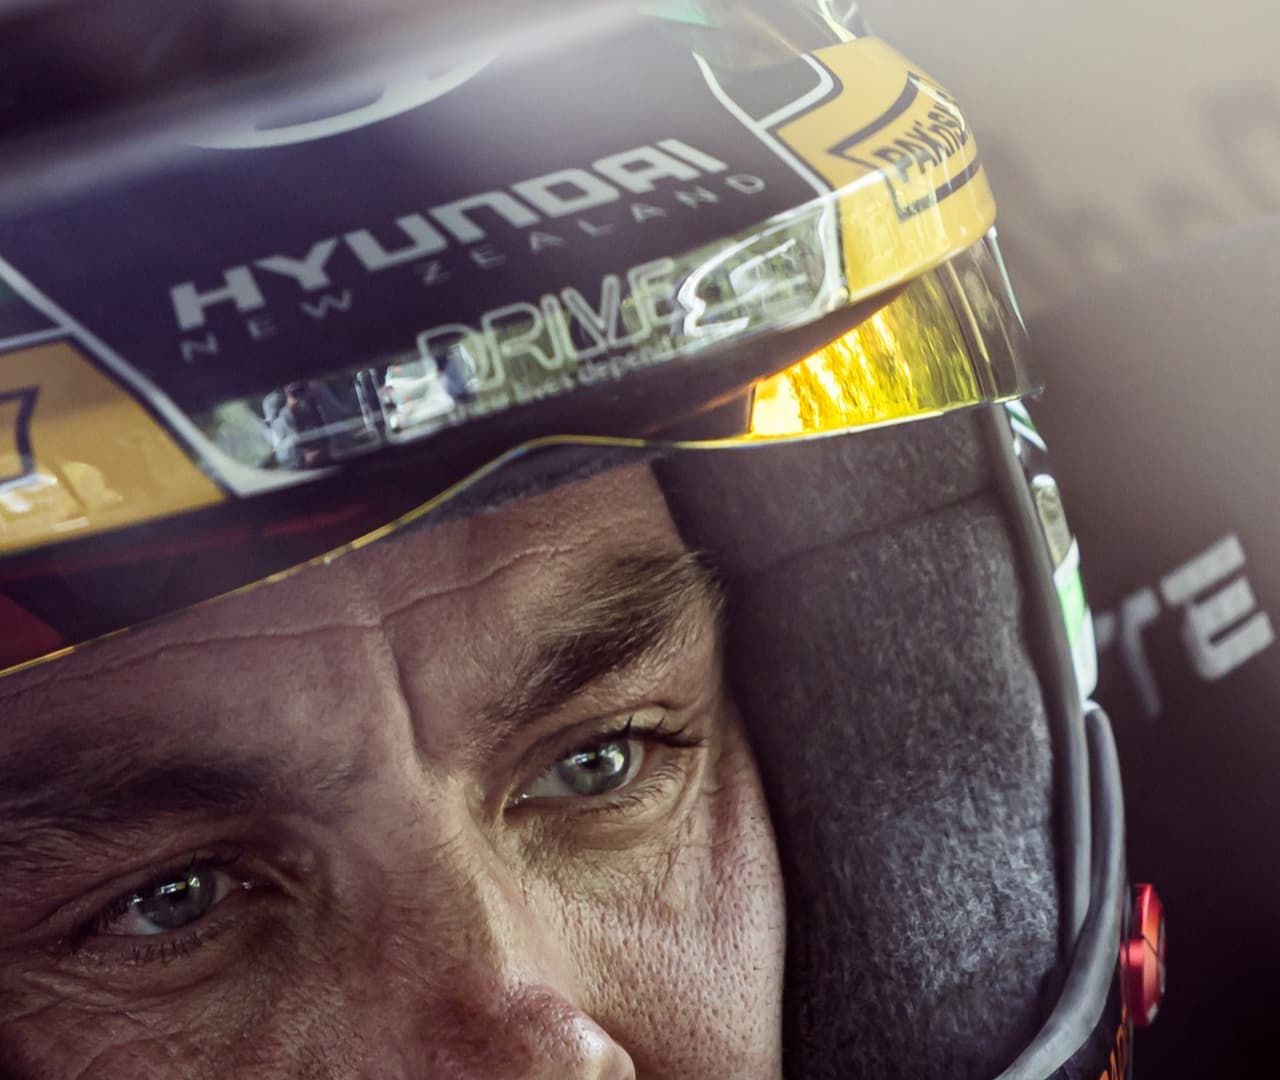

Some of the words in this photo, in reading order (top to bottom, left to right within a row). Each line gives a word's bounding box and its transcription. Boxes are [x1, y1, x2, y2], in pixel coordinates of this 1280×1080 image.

[170, 138, 728, 332] HYUNDAI
[180, 288, 353, 363] NEW
[420, 173, 766, 286] ZEALAND
[417, 257, 680, 391] DRIVE
